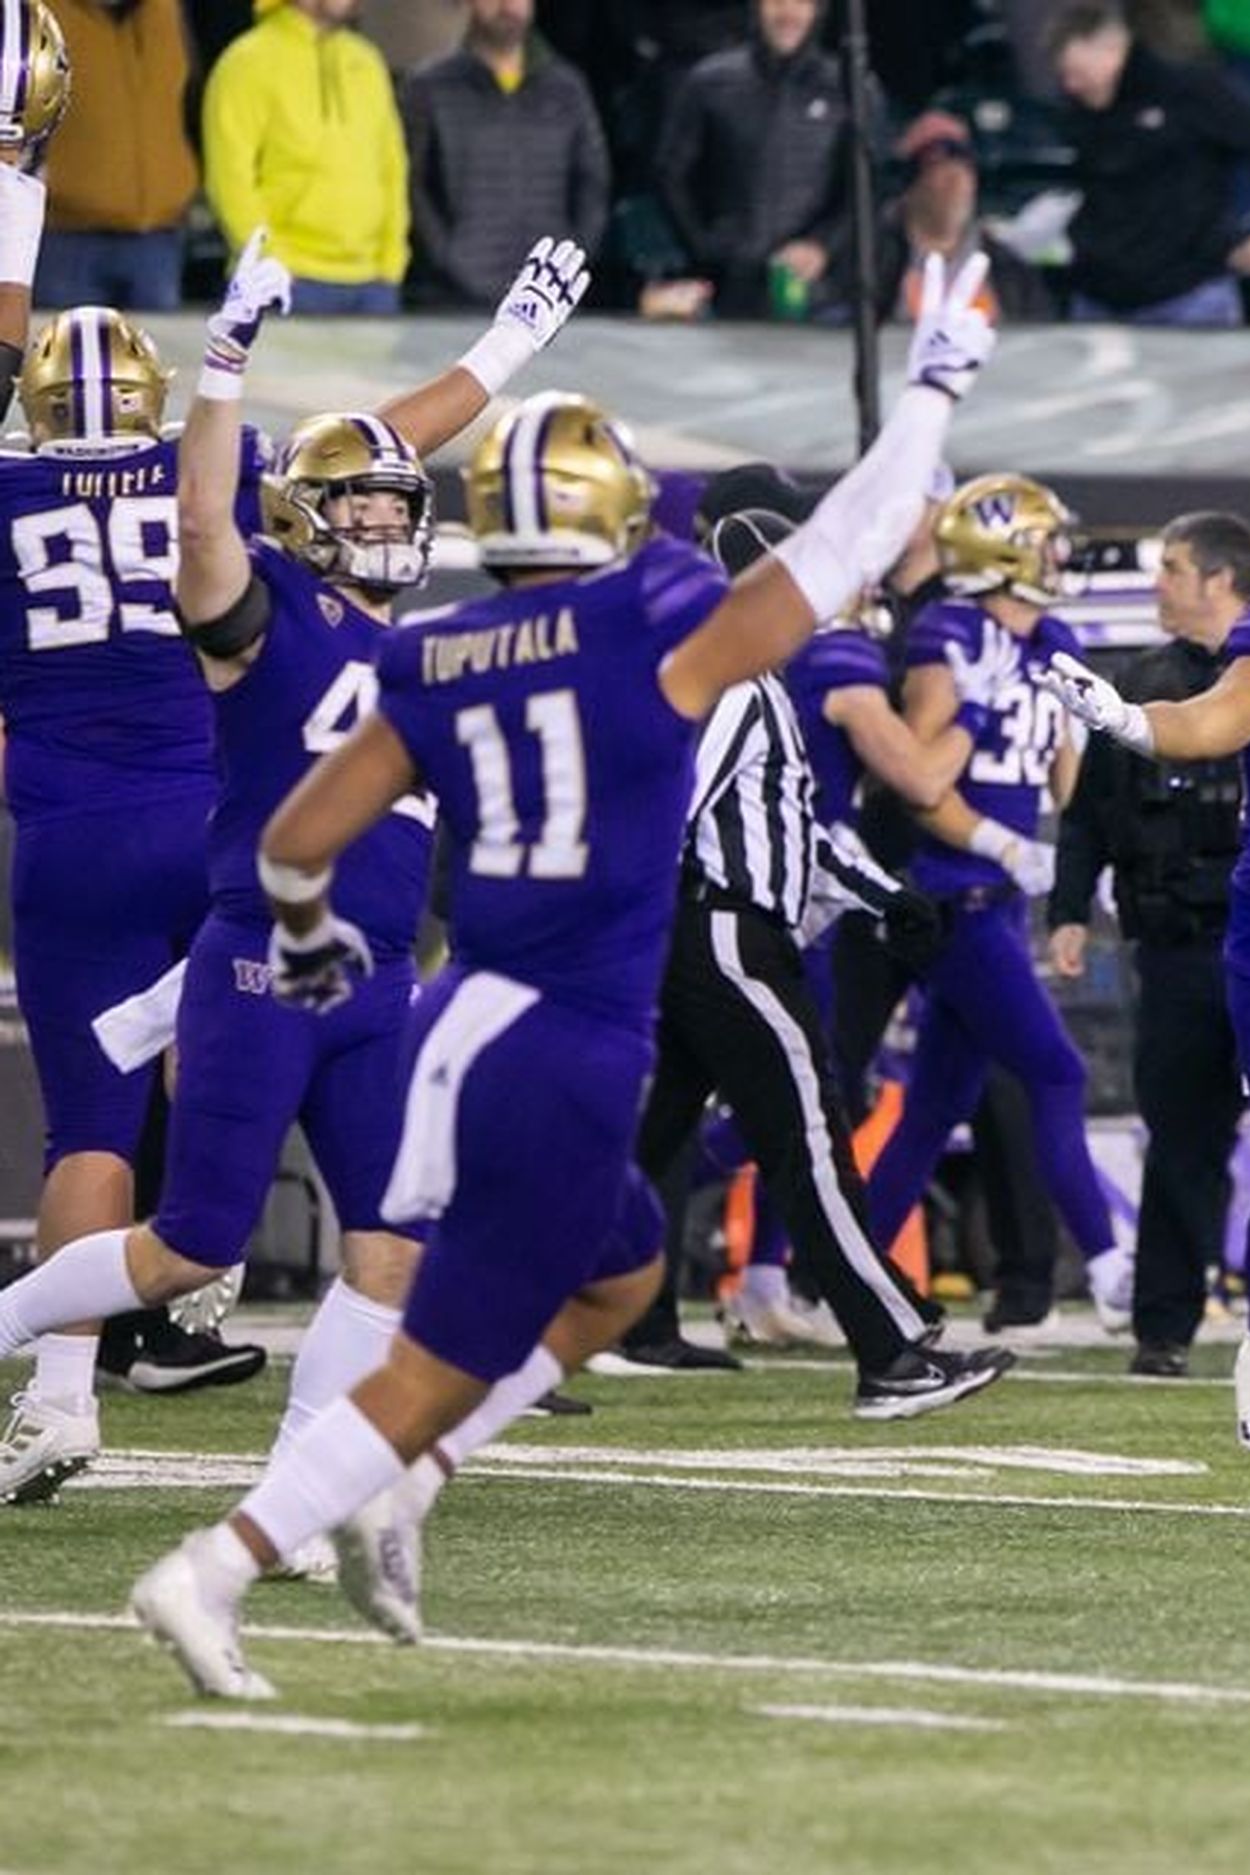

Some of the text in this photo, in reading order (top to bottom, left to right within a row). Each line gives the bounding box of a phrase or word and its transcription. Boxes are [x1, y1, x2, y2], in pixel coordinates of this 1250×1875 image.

[11, 496, 182, 651] 99
[973, 493, 1017, 528] W
[455, 687, 590, 878] 11
[969, 682, 1064, 786] 30
